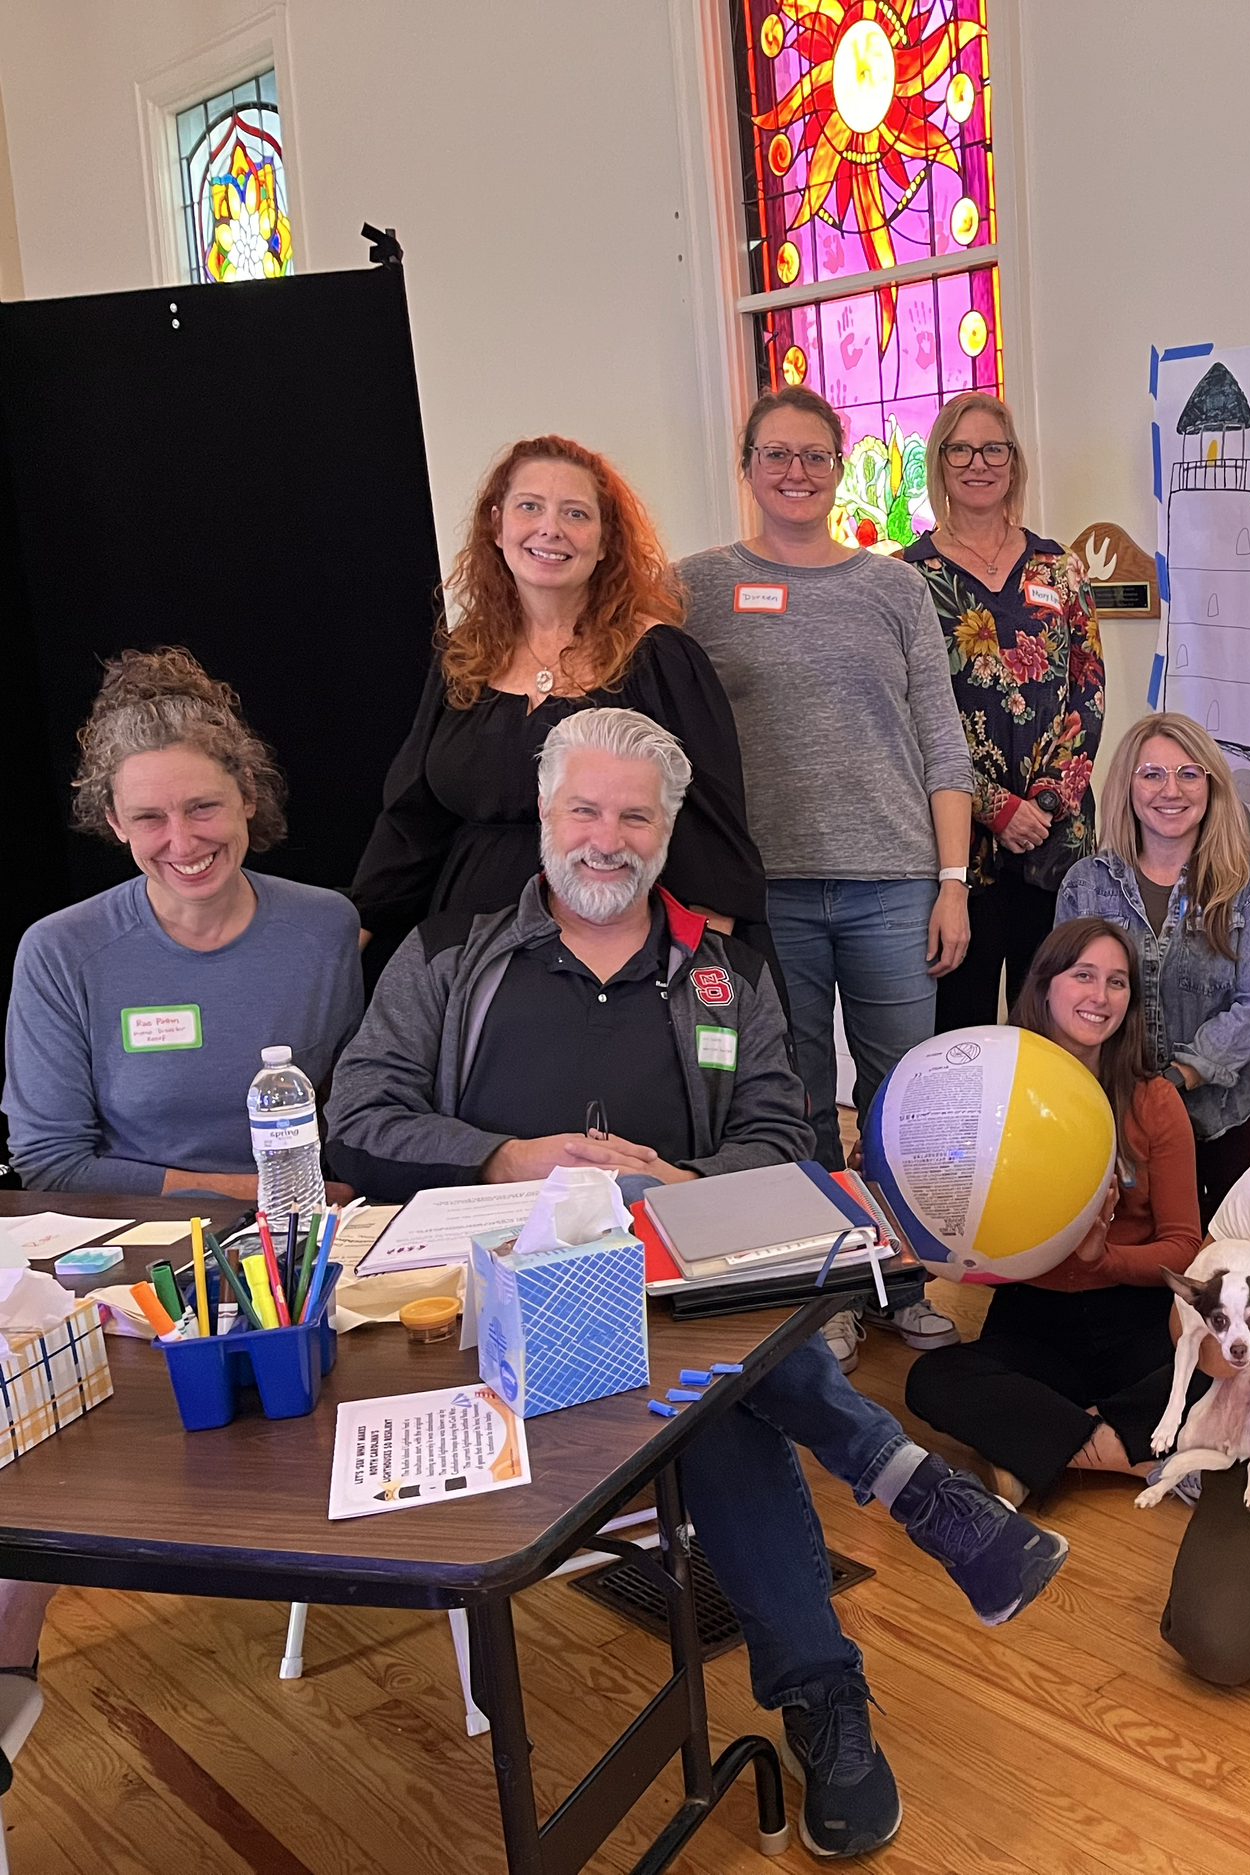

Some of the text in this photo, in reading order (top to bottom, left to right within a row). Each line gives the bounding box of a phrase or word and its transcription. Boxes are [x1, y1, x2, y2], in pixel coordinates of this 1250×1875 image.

[742, 593, 778, 602] Doreen
[357, 1426, 366, 1441] MAKES
[356, 1442, 365, 1457] WHAT
[368, 1430, 379, 1476] NORTH CAROLINA'S
[382, 1450, 392, 1483] LIGHTHOUSES
[354, 1471, 364, 1485] LET'S
